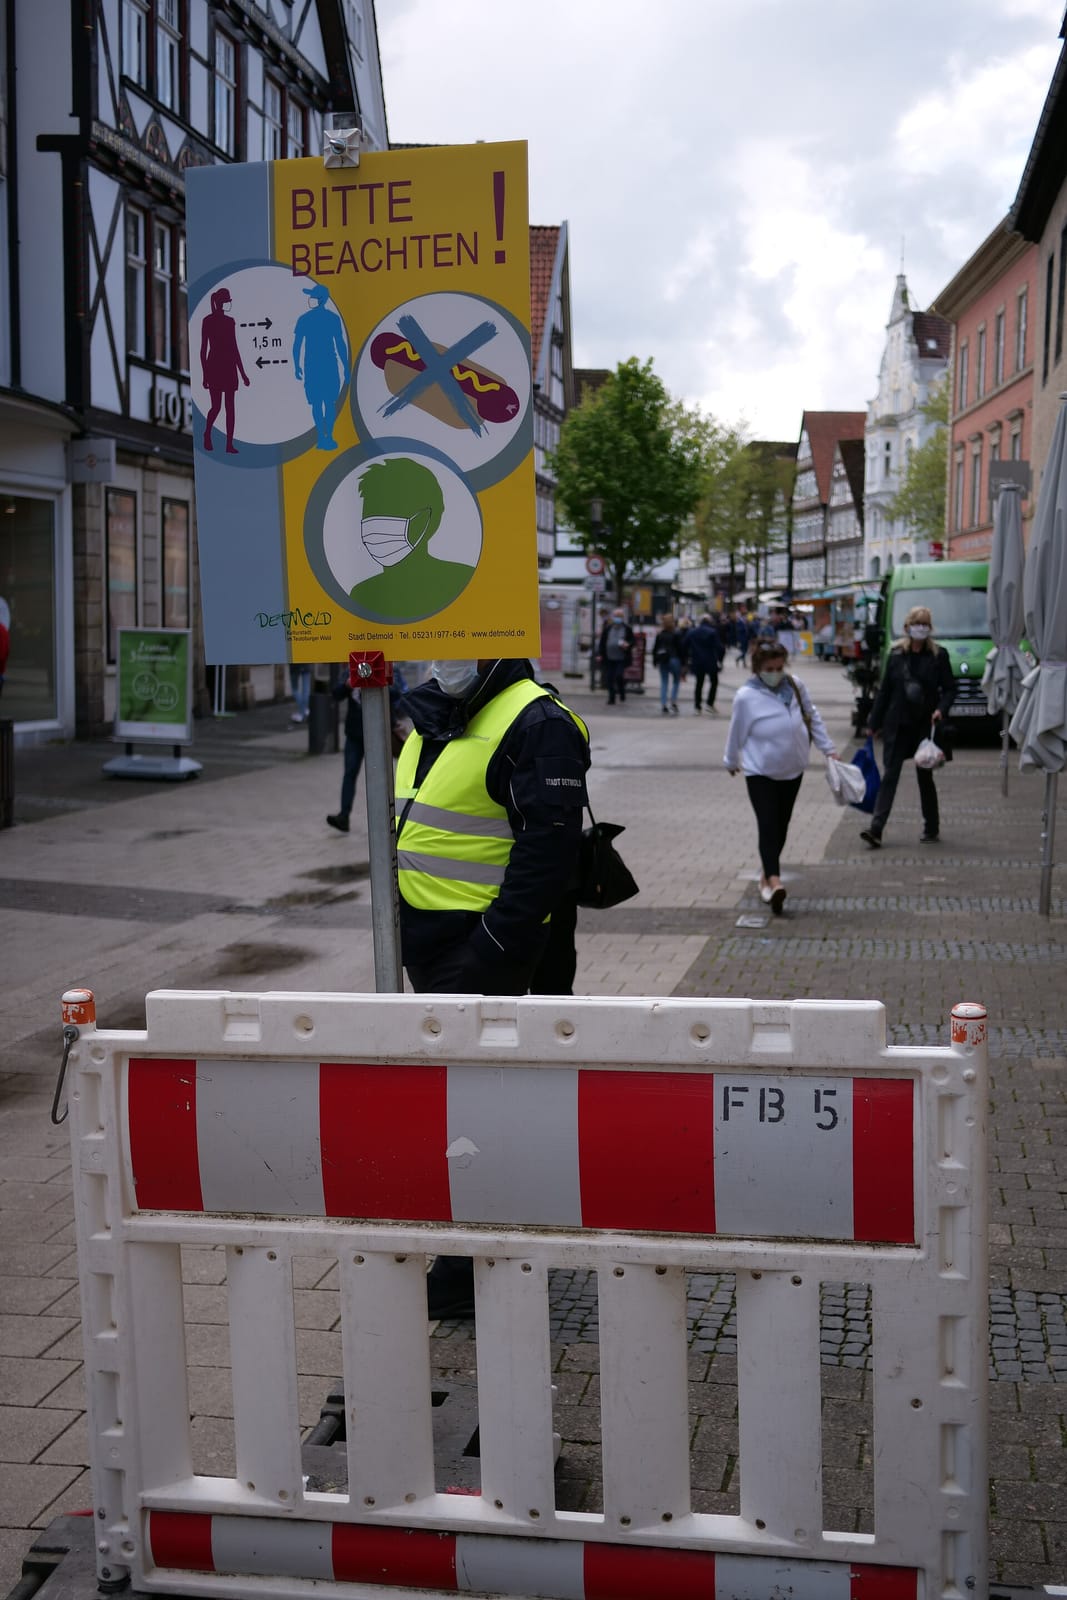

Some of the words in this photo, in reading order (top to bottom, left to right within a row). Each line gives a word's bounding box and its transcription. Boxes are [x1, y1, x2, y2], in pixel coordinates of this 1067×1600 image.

[291, 180, 413, 230] BITTE
[493, 171, 506, 265] !
[291, 232, 479, 277] BEACHTEN
[252, 336, 270, 349] 1,5
[271, 338, 282, 348] m
[348, 632, 366, 641] Stadt
[366, 631, 393, 640] Detmold
[471, 629, 526, 638] www.detmold.de
[722, 1085, 785, 1123] FB
[814, 1088, 839, 1131] 5
